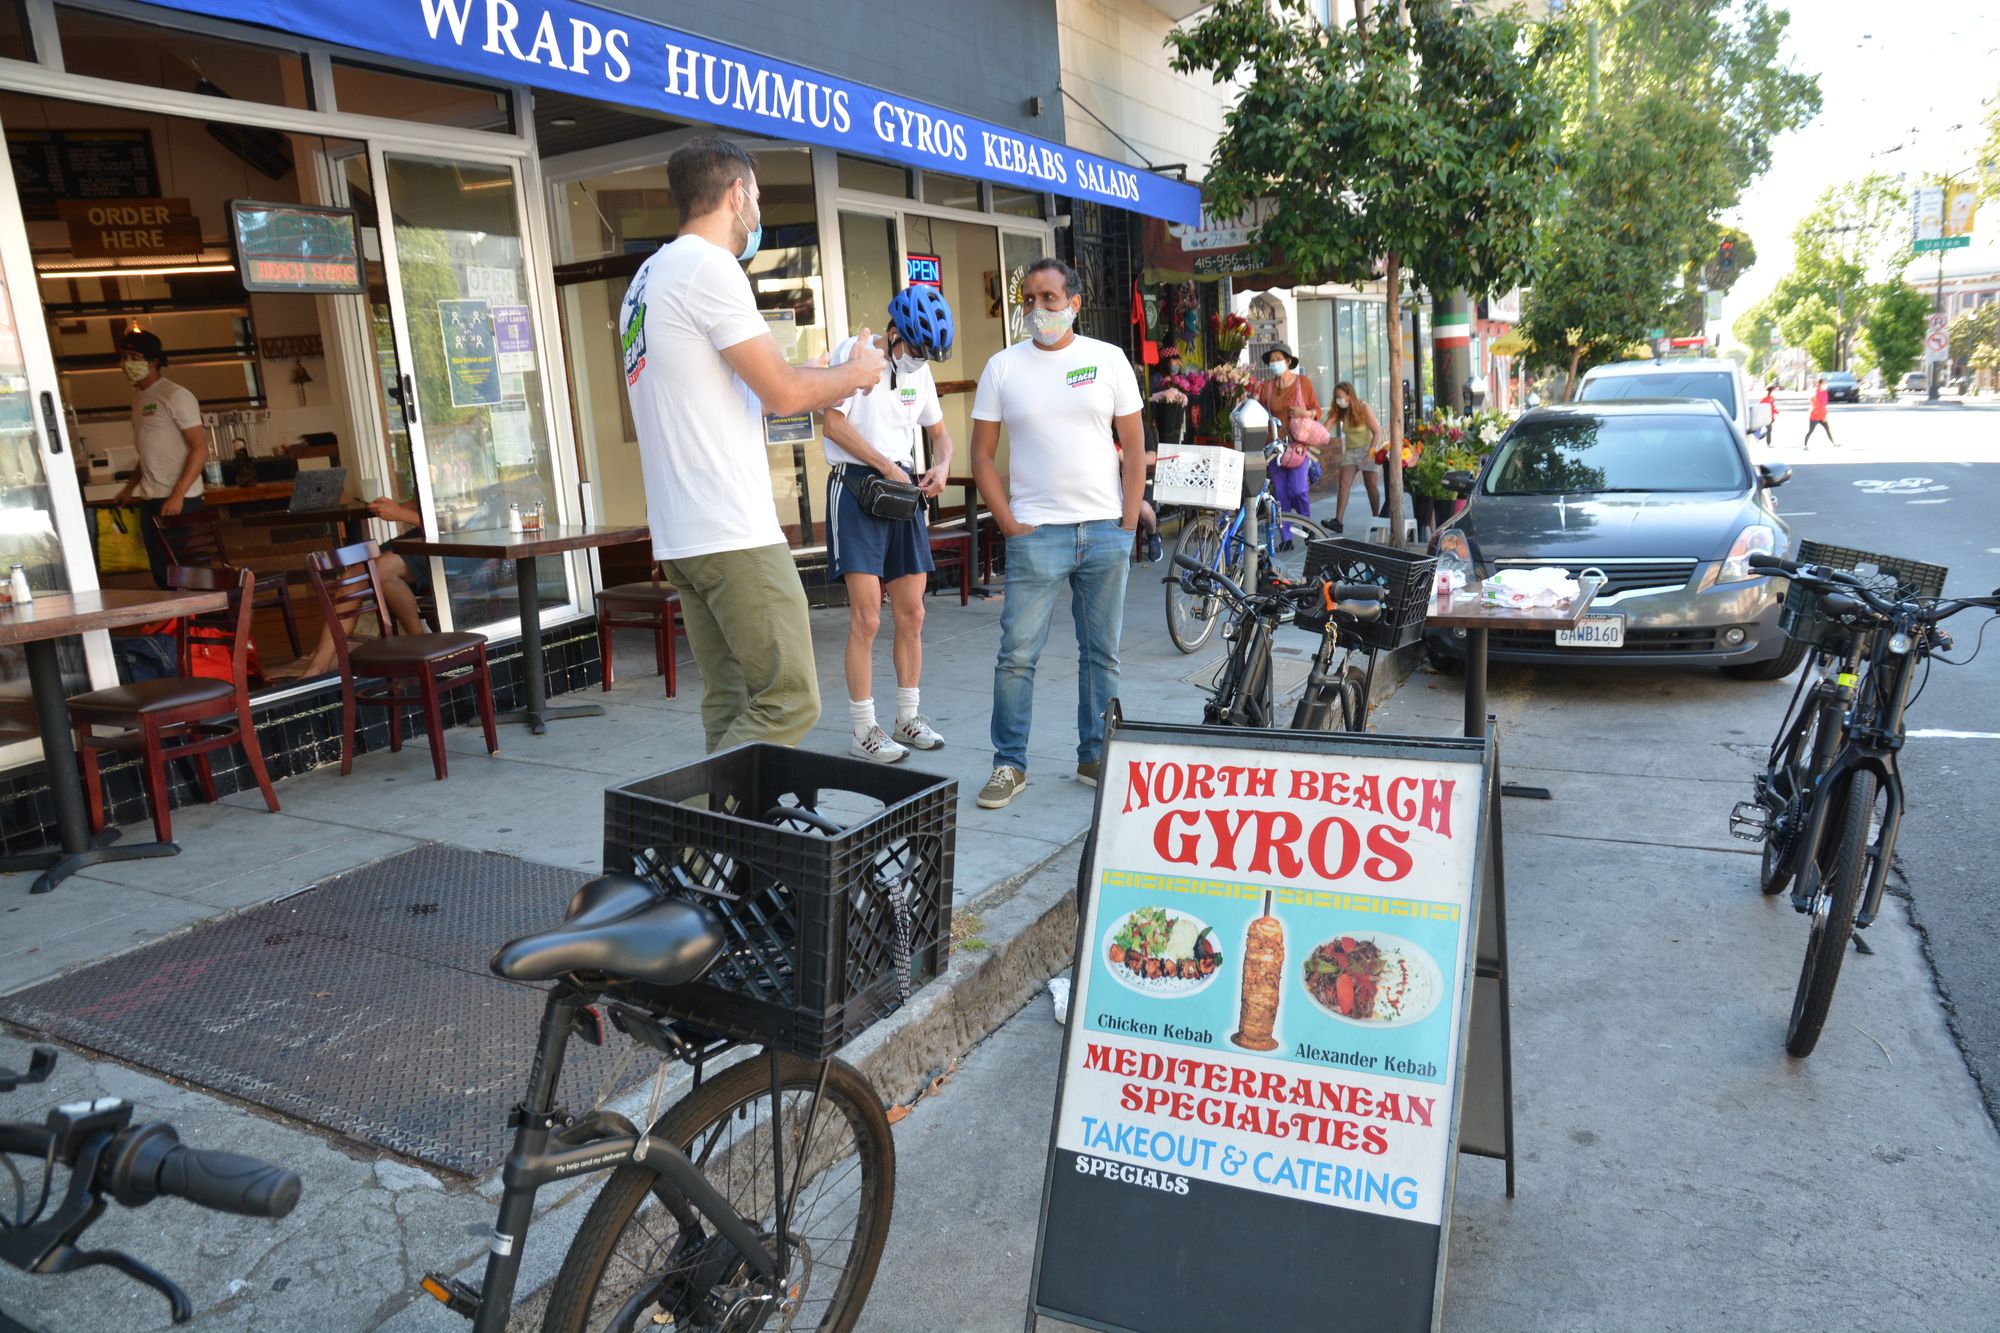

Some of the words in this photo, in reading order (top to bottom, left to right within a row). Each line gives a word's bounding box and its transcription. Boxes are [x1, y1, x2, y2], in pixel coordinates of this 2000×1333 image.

[419, 0, 631, 82] WRAPS
[664, 43, 851, 133] HUMMUS
[873, 101, 967, 161] GYROS
[982, 131, 1067, 184] KEBABS
[1076, 159, 1139, 202] SALADS
[87, 206, 171, 226] ORDER
[101, 229, 165, 249] HERE
[257, 262, 305, 280] BEACH
[313, 263, 356, 281] GYROS
[1009, 264, 1025, 304] NORTH
[1067, 371, 1095, 385] BEACH
[1561, 626, 1619, 641] 6AWB160
[1122, 760, 1278, 814] NORTH
[1288, 769, 1456, 840] BEACH
[1153, 809, 1413, 882] GYROS
[1097, 1013, 1158, 1036] Chicken
[1163, 1023, 1213, 1044] Kebab
[1295, 1043, 1378, 1069] Alexander
[1384, 1055, 1437, 1078] Kebab
[1082, 1043, 1436, 1127] MEDITERRANEAN
[1120, 1083, 1389, 1155] SPECIALTIES
[1075, 1156, 1189, 1195] SPECIALS
[1081, 1116, 1217, 1171] TAKEOUT
[1220, 1145, 1248, 1177] &
[1252, 1151, 1418, 1210] CATERING
